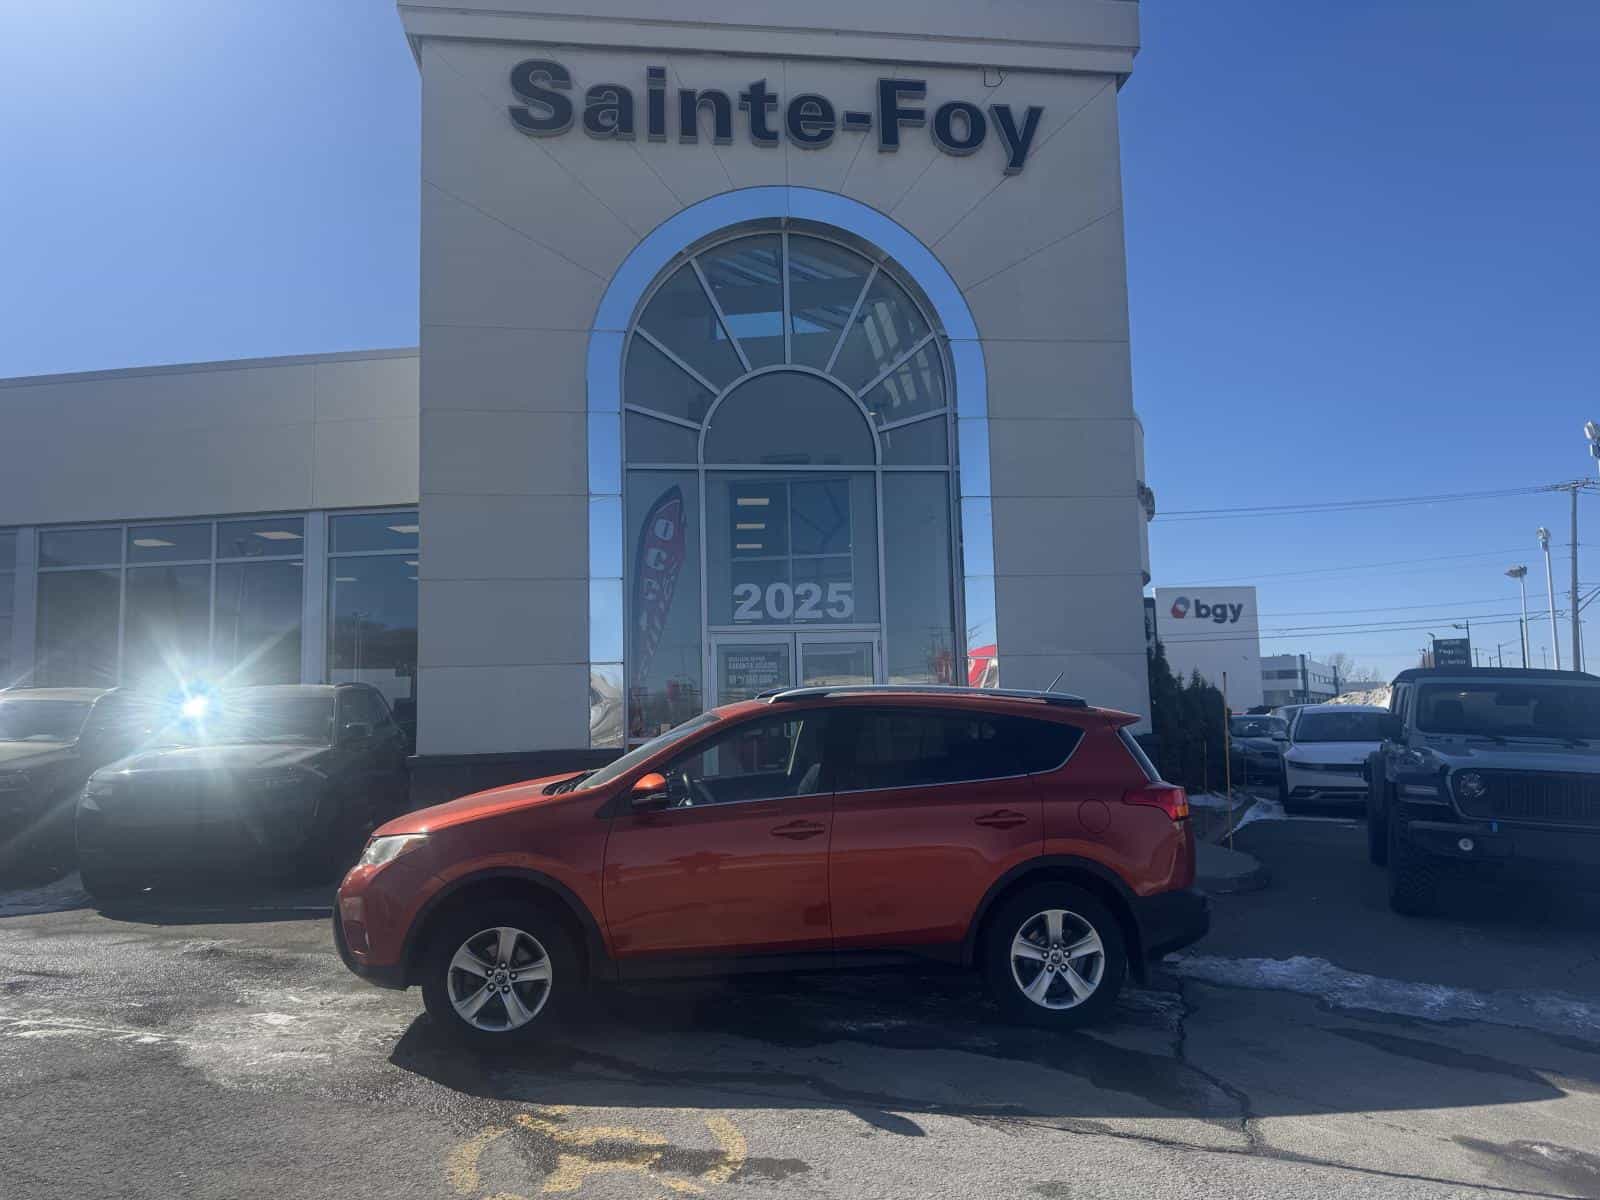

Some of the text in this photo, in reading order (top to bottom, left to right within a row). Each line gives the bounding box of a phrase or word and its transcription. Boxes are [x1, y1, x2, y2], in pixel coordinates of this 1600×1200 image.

[508, 58, 1044, 176] Sainte-Foy
[733, 582, 854, 620] 2025
[1194, 598, 1243, 624] bgy
